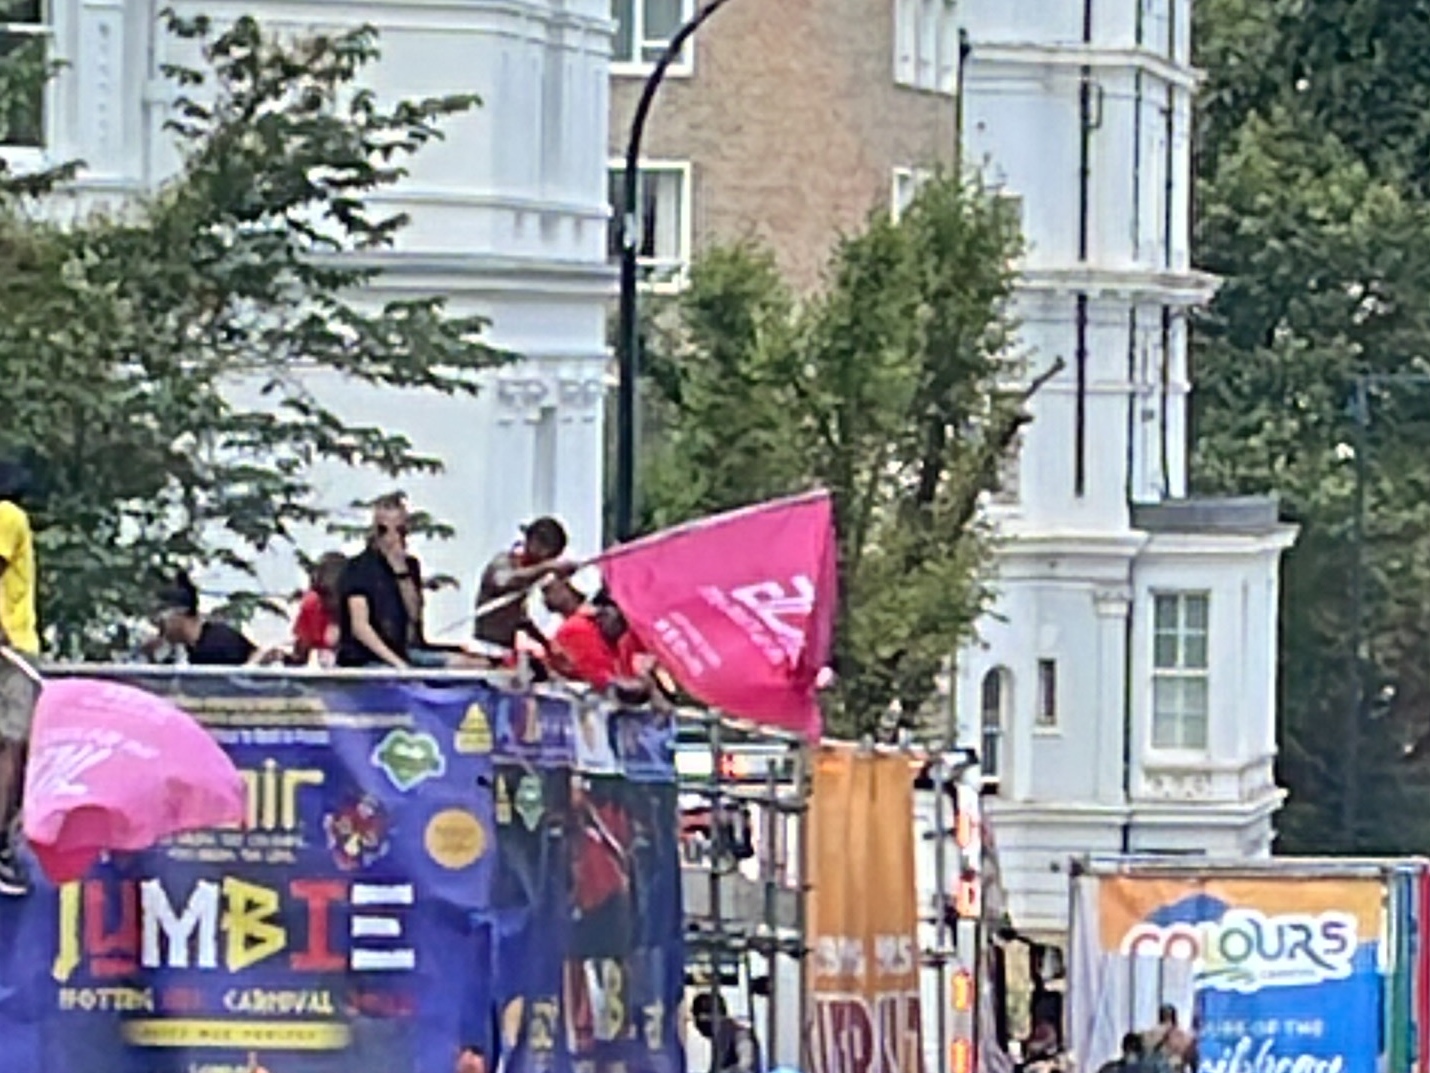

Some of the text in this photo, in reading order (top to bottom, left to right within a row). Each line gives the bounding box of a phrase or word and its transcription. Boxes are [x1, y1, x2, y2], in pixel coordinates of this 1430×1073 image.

[52, 876, 414, 982] JUMBIE
[1129, 917, 1348, 971] COLOURS
[223, 988, 333, 1013] CARNIVAL
